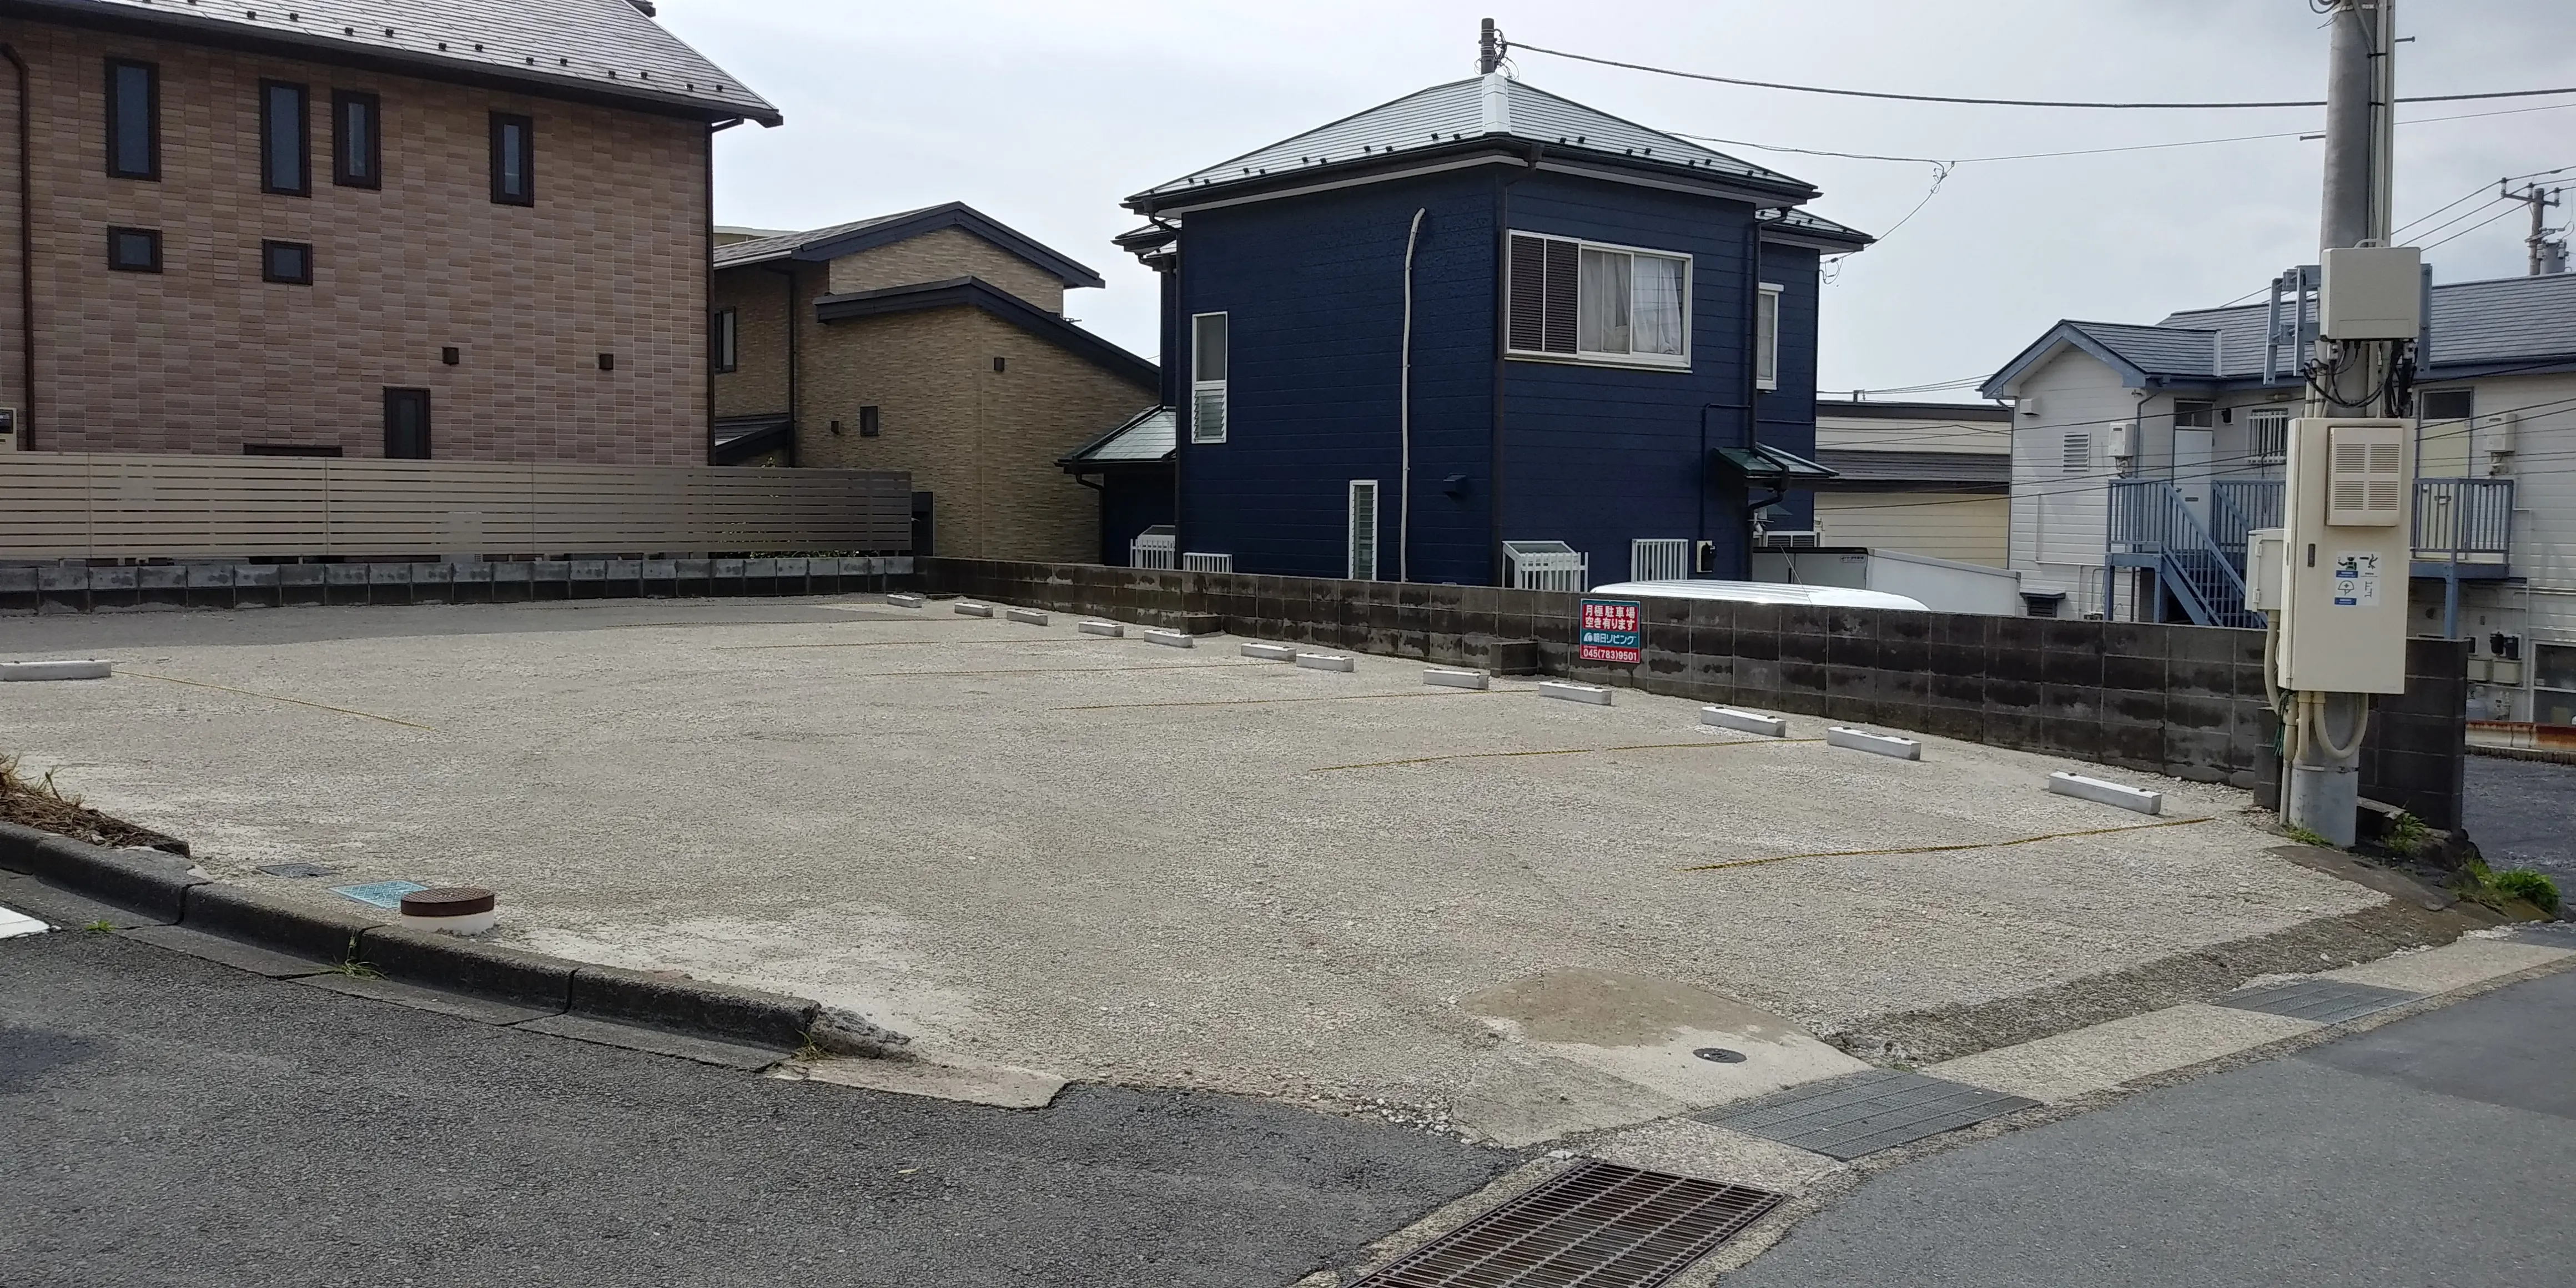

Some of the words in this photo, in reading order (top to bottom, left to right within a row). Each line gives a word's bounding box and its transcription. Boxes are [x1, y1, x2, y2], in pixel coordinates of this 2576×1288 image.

[1586, 605, 1635, 618] 月極駐車場
[1585, 617, 1635, 631] 空き有ります
[1583, 648, 1637, 661] 045(783)9501
